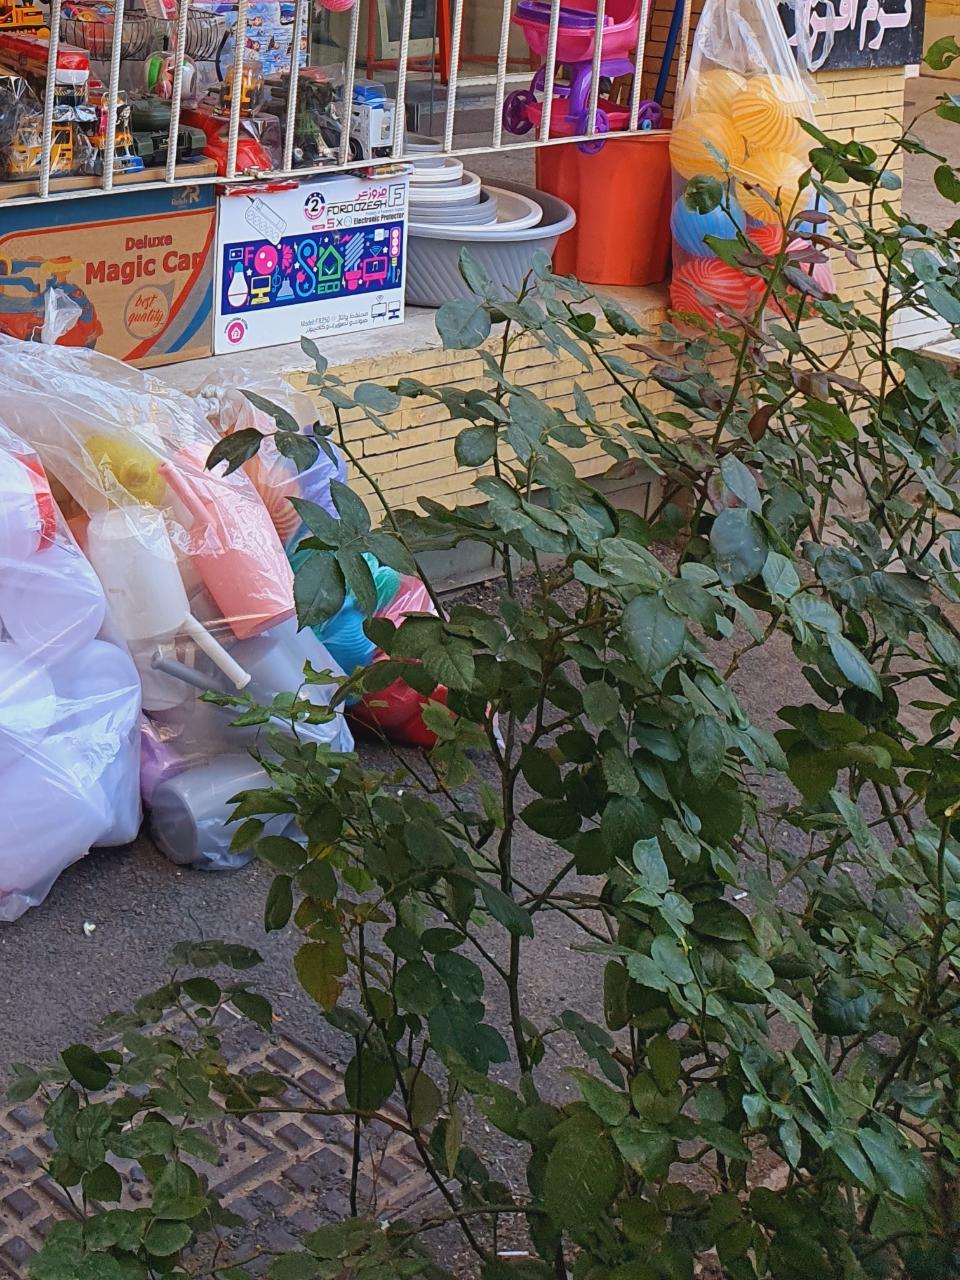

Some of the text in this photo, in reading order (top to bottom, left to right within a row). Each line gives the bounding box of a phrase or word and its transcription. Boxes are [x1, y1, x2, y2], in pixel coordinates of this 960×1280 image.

[125, 235, 172, 251] Deluxe
[85, 251, 203, 285] Magic Car
[317, 282, 340, 294] ECO
[135, 294, 157, 309] best
[128, 310, 166, 327] quality
